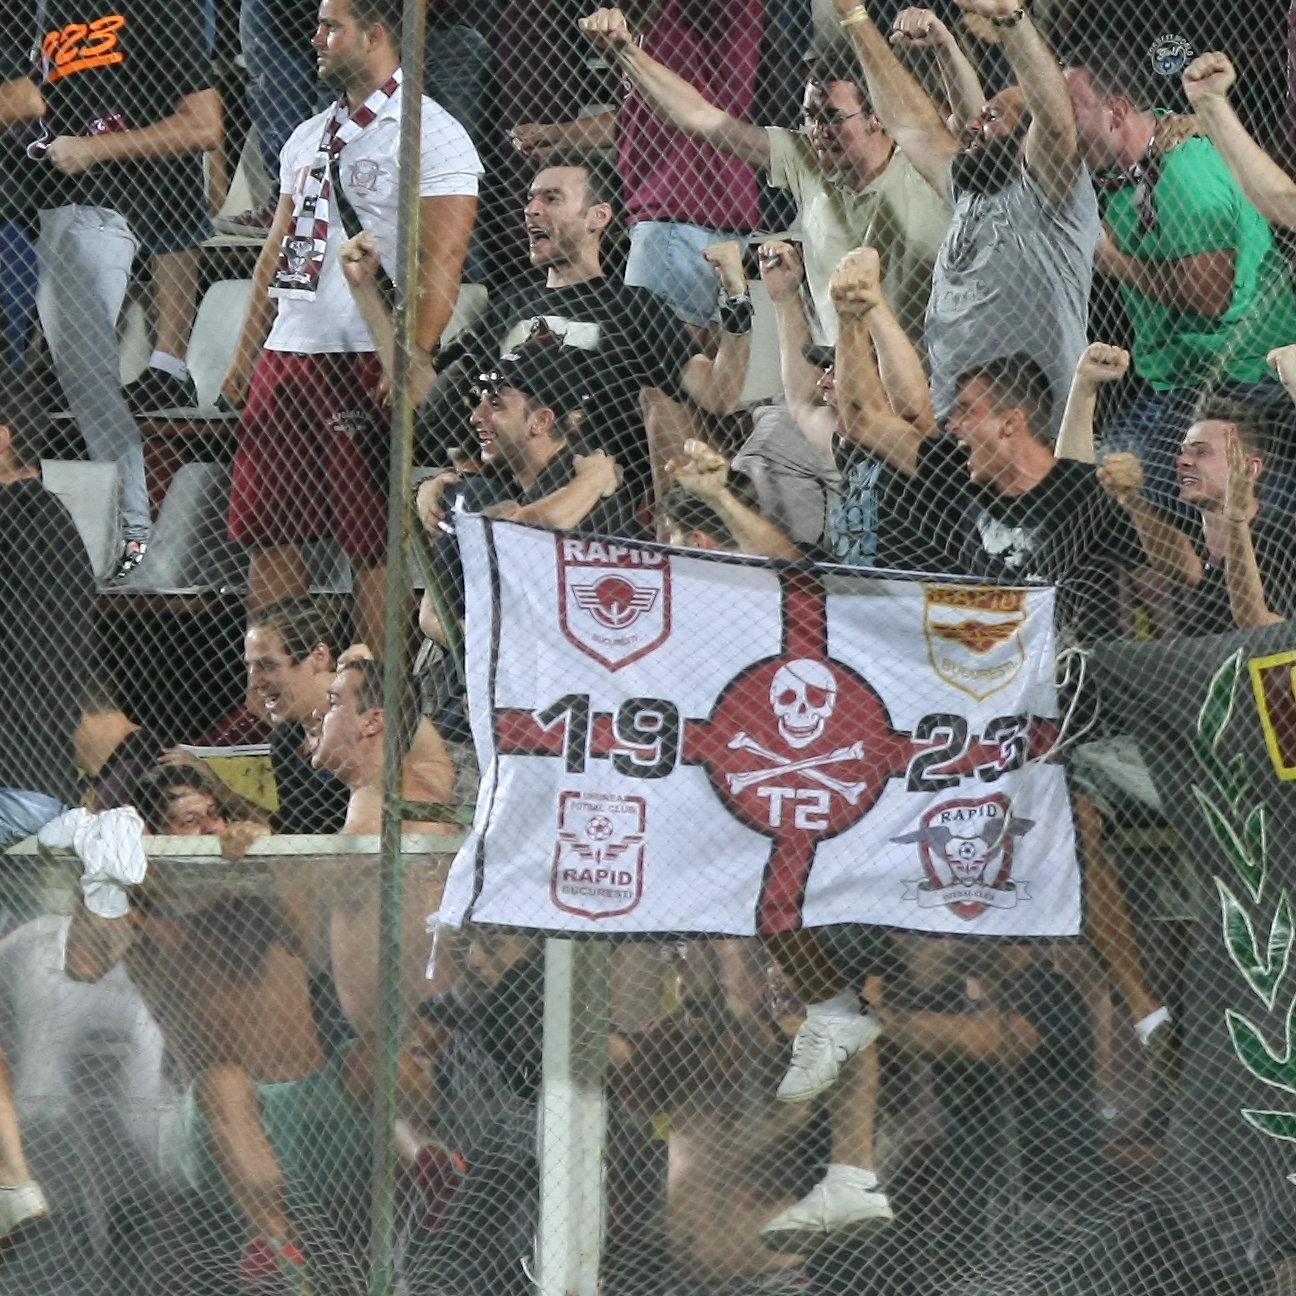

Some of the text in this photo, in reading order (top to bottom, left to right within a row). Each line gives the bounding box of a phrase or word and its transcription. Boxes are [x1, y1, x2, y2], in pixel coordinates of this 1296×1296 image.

[563, 539, 664, 564] RAPID
[531, 693, 1030, 794] 19 23
[941, 803, 998, 824] RAPID
[562, 868, 633, 886] RAPID
